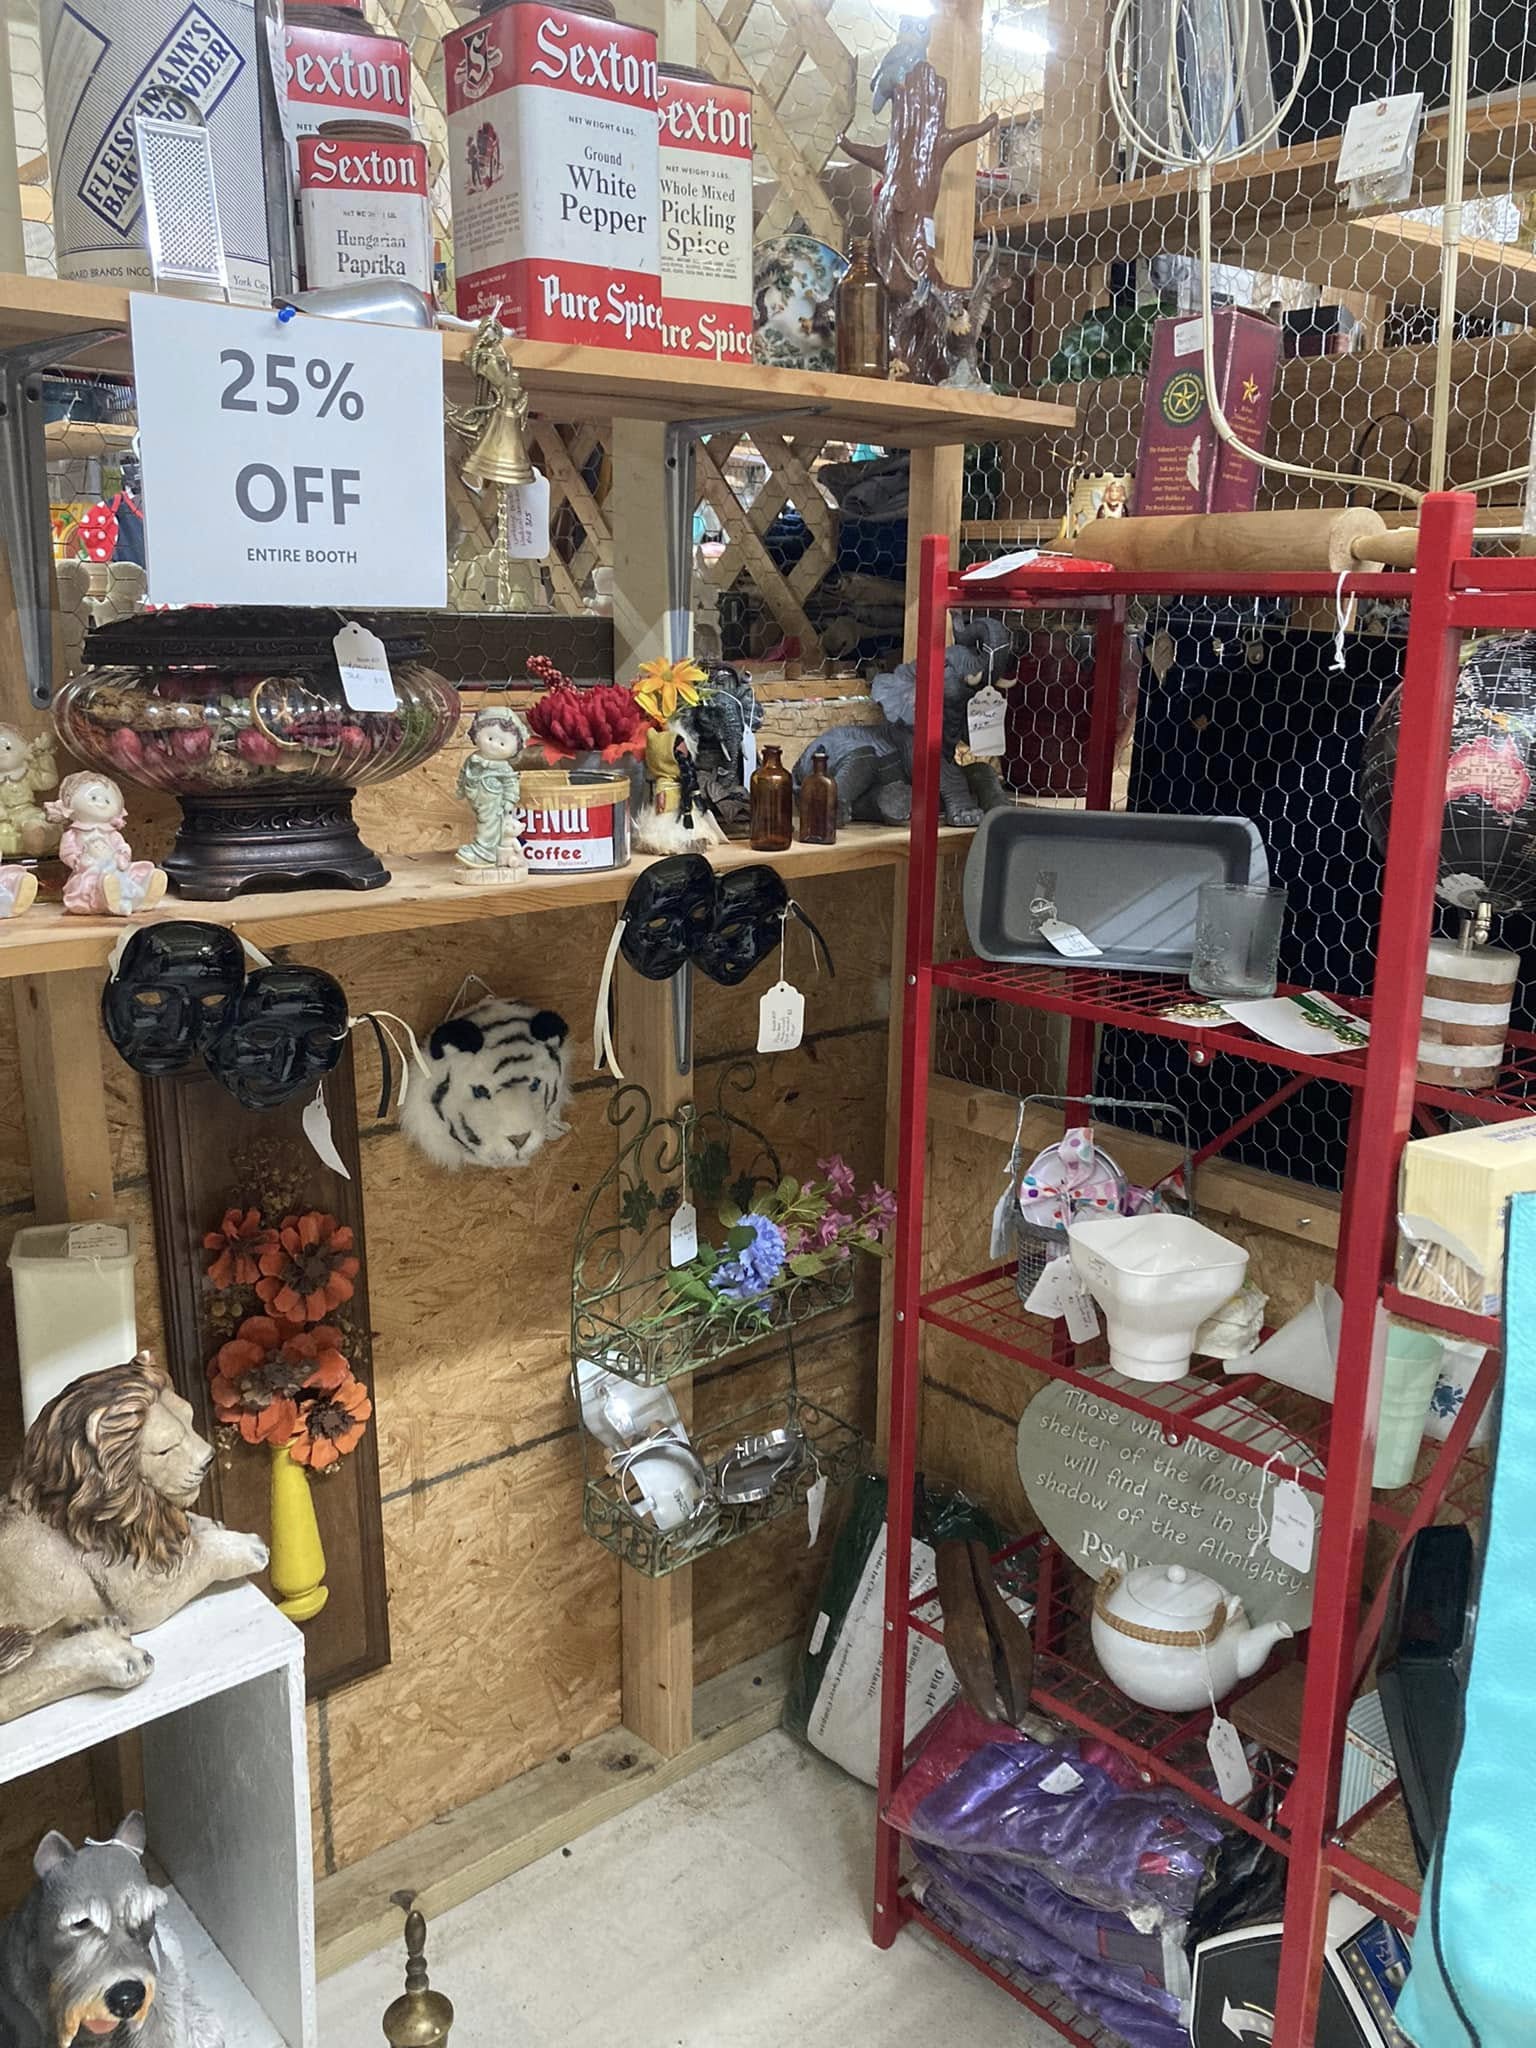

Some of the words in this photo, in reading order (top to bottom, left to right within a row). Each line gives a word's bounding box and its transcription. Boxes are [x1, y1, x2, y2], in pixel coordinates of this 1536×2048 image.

[288, 48, 405, 106] exton
[530, 17, 658, 103] Sexton
[569, 115, 583, 125] NET
[584, 118, 614, 131] WEIGHT
[658, 97, 752, 150] exton
[310, 142, 418, 187] Sexton
[584, 145, 622, 166] Ground
[566, 163, 637, 200] White
[660, 179, 698, 197] Whole
[702, 184, 736, 202] Mixed
[560, 192, 647, 234] Pepper
[662, 199, 736, 235] Pickling
[336, 229, 407, 250] Hungarian
[667, 227, 730, 256] Spice
[91, 267, 123, 278] BRANDS
[233, 274, 252, 289] York
[336, 252, 407, 279] Paprika
[537, 274, 600, 323] Pure
[219, 348, 364, 421] 25%
[235, 462, 361, 525] OFF
[247, 548, 301, 563] ENTIRE
[305, 549, 357, 563] BOOTH
[523, 846, 582, 860] Coffee
[1065, 1390, 1121, 1425] Those
[1184, 1435, 1220, 1461] live
[1039, 1412, 1110, 1450] shelter
[1119, 1447, 1146, 1465] of
[1153, 1456, 1189, 1483] the
[1200, 1474, 1259, 1510] Most
[1064, 1453, 1099, 1478] will
[1107, 1467, 1148, 1497] find
[1157, 1491, 1203, 1519] rest
[1212, 1509, 1235, 1533] in
[1247, 1523, 1272, 1549] th
[1035, 1471, 1109, 1511] shadow
[1117, 1507, 1145, 1526] of
[1151, 1514, 1187, 1545] the
[1198, 1537, 1310, 1595] Almighty.
[929, 1669, 945, 1690] Dia
